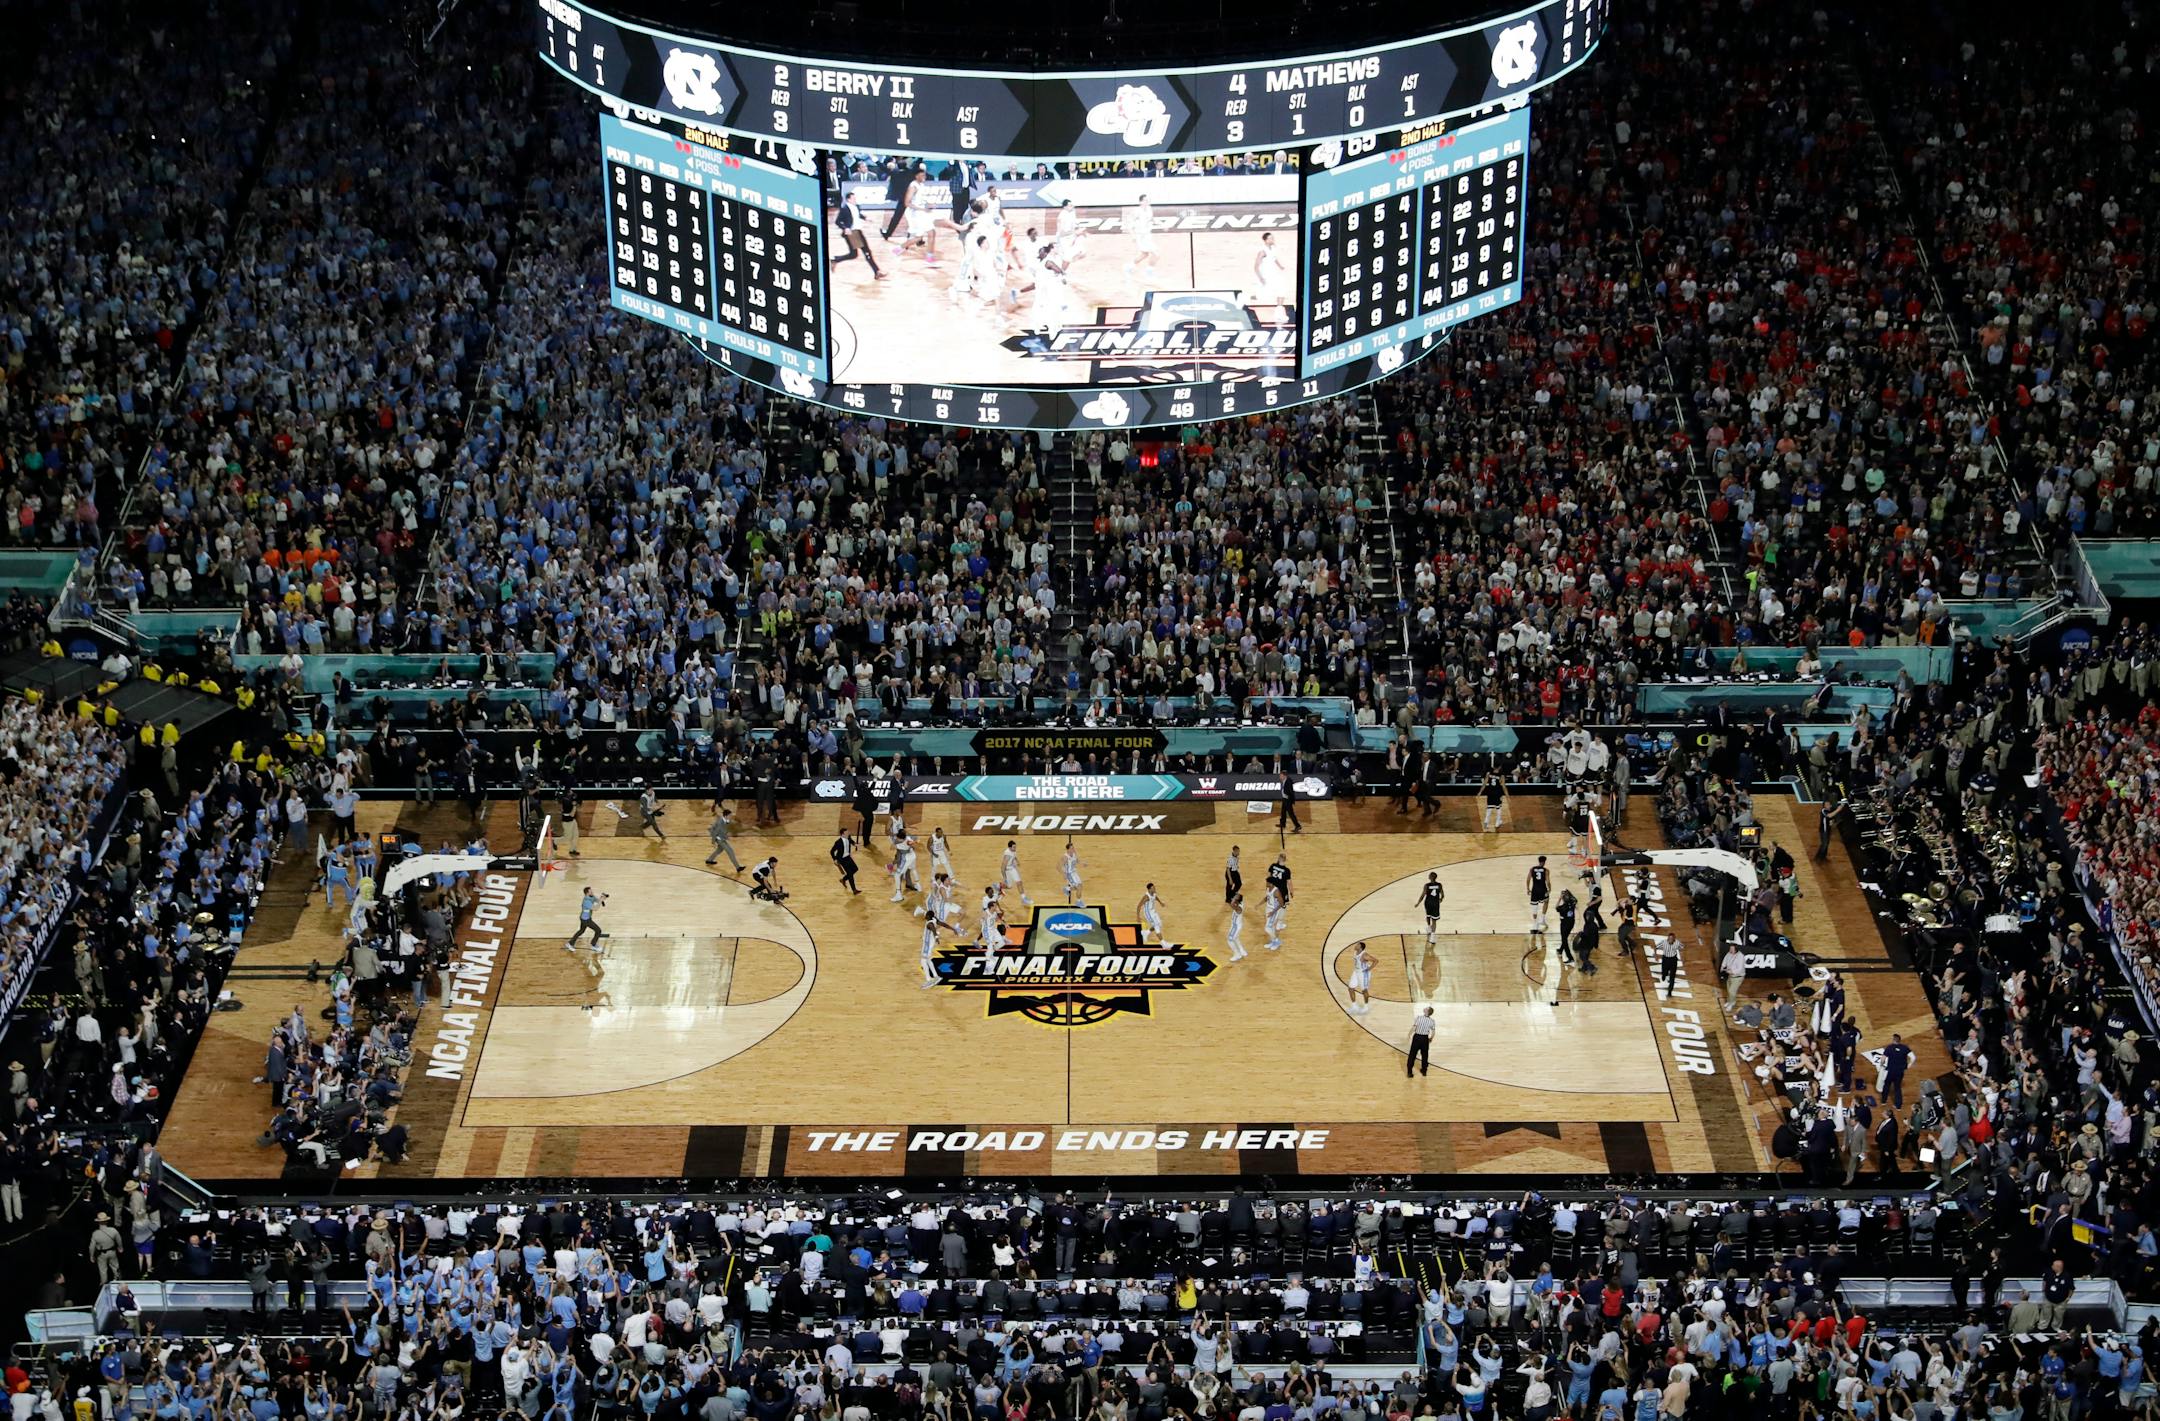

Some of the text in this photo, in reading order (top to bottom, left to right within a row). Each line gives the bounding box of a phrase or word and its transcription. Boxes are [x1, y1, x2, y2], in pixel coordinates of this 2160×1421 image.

[596, 64, 604, 85] 1
[775, 65, 914, 98] 2 BERRY II
[1229, 56, 1380, 95] 4 MATHEWS
[771, 89, 979, 122] REB STL BLK AST
[1225, 74, 1419, 116] REB STL BLK AST
[774, 110, 977, 148] 3 2 1 6
[1227, 96, 1415, 142] 3 1 0 1
[1401, 130, 1421, 147] 2ND
[1421, 121, 1446, 141] HALF
[685, 128, 730, 151] 2ND HALF
[693, 145, 722, 164] BONUS
[1408, 140, 1438, 158] BONUS
[1433, 186, 1440, 203] 1
[1458, 176, 1469, 194] 6
[1507, 160, 1517, 178] 2
[1320, 196, 1410, 240] 3 9 5 4
[1431, 186, 1516, 229] 2 22 3 3
[1318, 222, 1408, 265] 4 6 3 1
[1430, 211, 1514, 255] 3 7 10 4
[1319, 248, 1408, 293] 5 15 9 3
[1428, 236, 1513, 279] 4 13 9 4
[1314, 274, 1408, 320] 13 13 2 3
[1423, 262, 1512, 306] 44 16 4 2
[621, 294, 650, 314] FOULS
[674, 313, 692, 329] TOL
[699, 321, 707, 335] 0
[1312, 299, 1406, 347] 24 9 9 4
[1424, 288, 1511, 329] FOULS 10 TOL 2
[724, 331, 816, 373] FOULS 10 TOL 2
[1050, 330, 1192, 350] FINAL
[1314, 326, 1407, 369] FOULS 10 TOL 0
[844, 391, 1000, 422] 45 7 8 15
[980, 392, 998, 404] AST
[1223, 397, 1235, 413] 2
[1266, 390, 1277, 405] 5
[1303, 380, 1319, 397] 11
[985, 736, 1153, 749] 2017 NCAA FINAL FOUR
[909, 783, 951, 794] ACC
[1016, 786, 1124, 799] ENDS HERE
[1032, 776, 1108, 787] THE ROAD
[1235, 782, 1281, 791] GONZAGA
[972, 815, 1168, 831] PHOENIX
[1272, 869, 1283, 880] 24
[1535, 872, 1542, 880] 3
[1430, 889, 1437, 897] 4
[1050, 922, 1094, 932] NCAA
[425, 873, 519, 1080] NCAA FINAL FOUR
[960, 955, 1176, 975] FINAL FOUR
[1738, 953, 1777, 970] CAA
[1004, 976, 1135, 984] PHOENIX 2017
[1661, 1007, 1716, 1075] FOUR
[808, 1129, 1330, 1151] THE ROAD ENDS HERE
